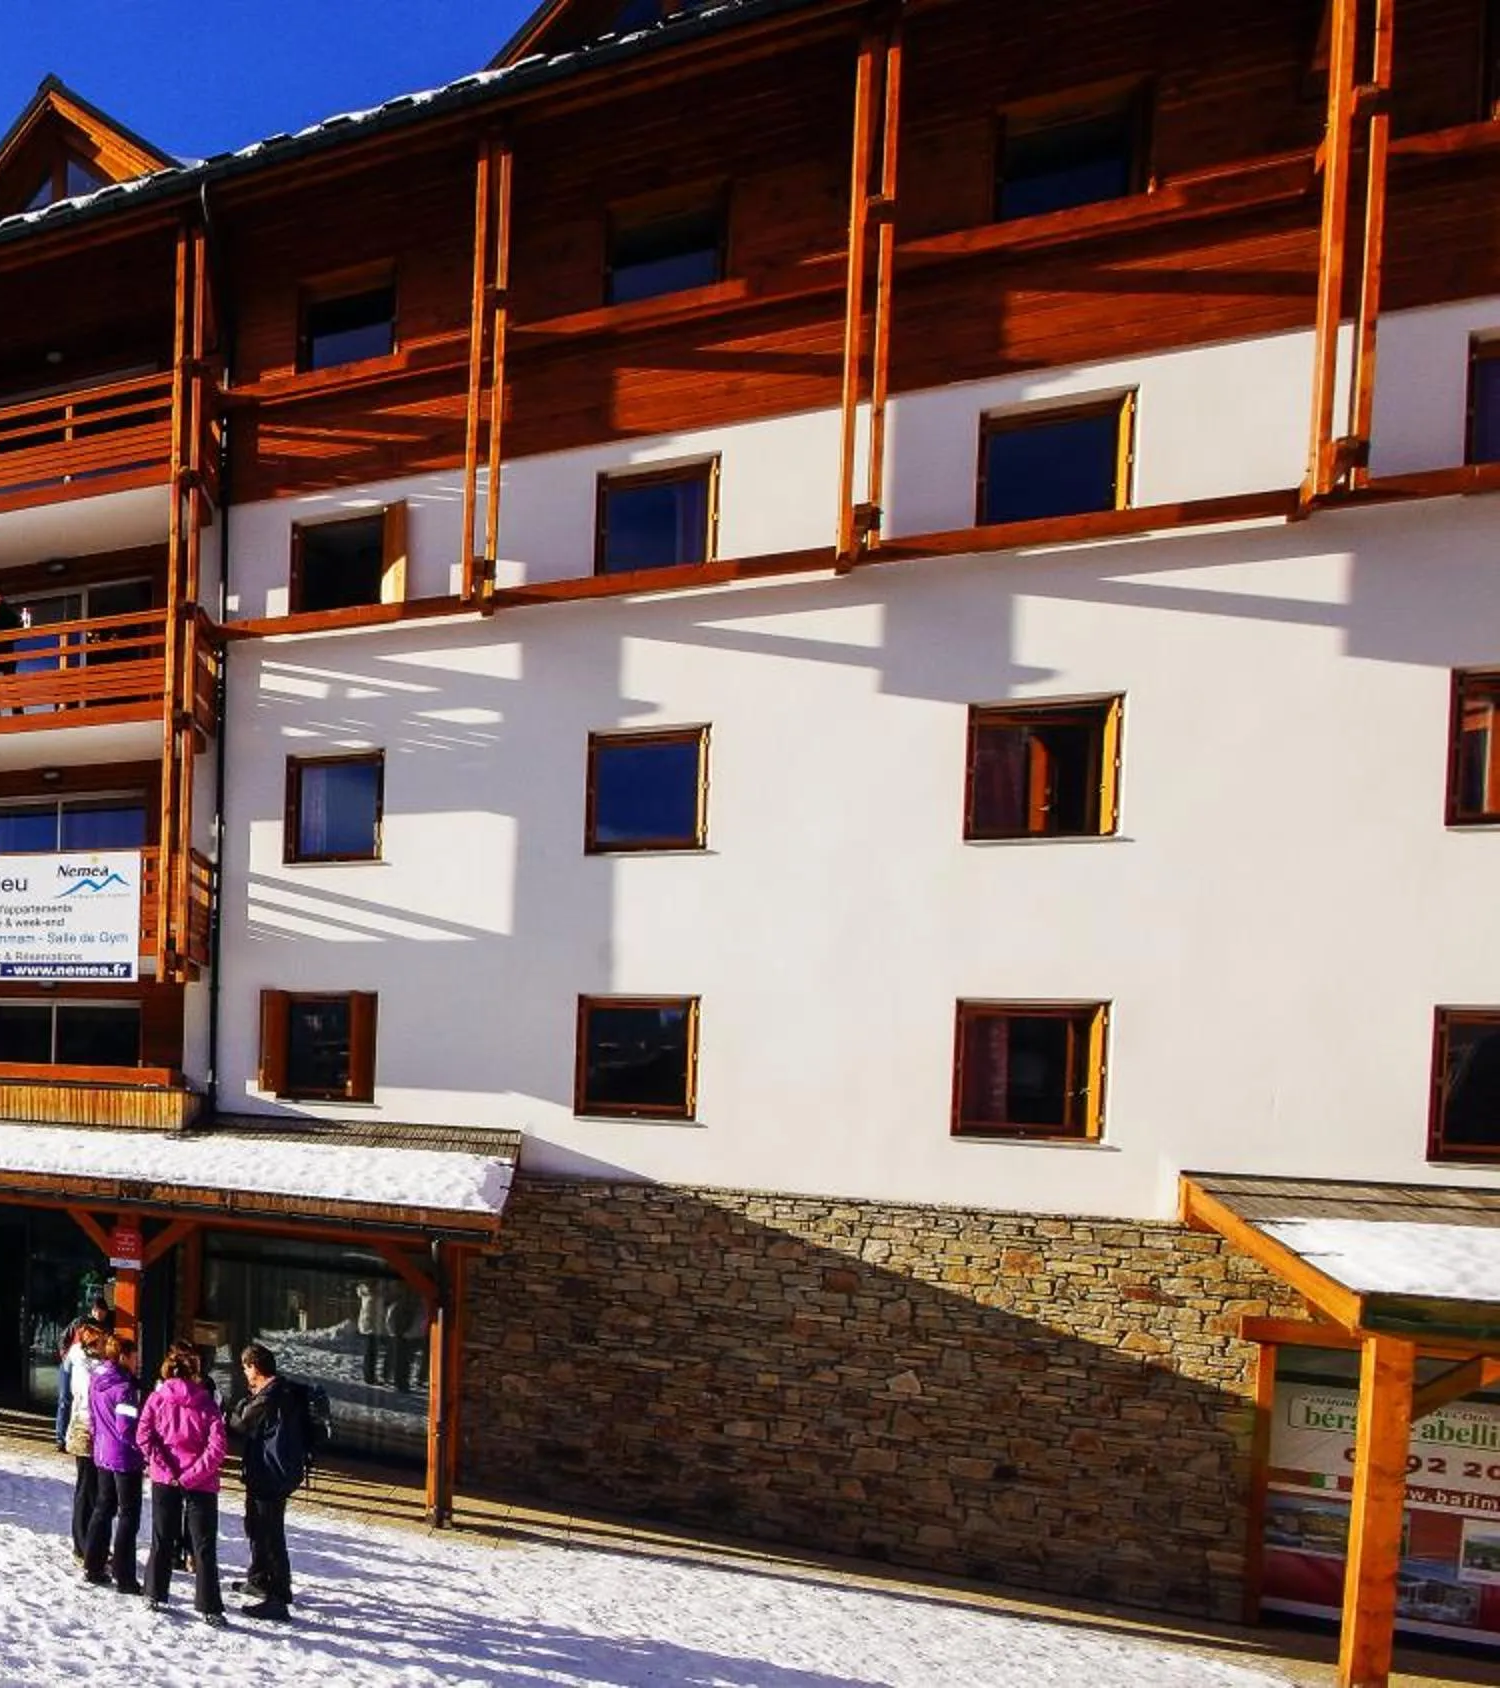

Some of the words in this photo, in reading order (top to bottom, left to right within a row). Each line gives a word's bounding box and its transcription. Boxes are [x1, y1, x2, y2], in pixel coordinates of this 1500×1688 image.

[15, 918, 66, 927] week-end
[47, 932, 77, 944] Salle
[99, 931, 129, 946] Gym
